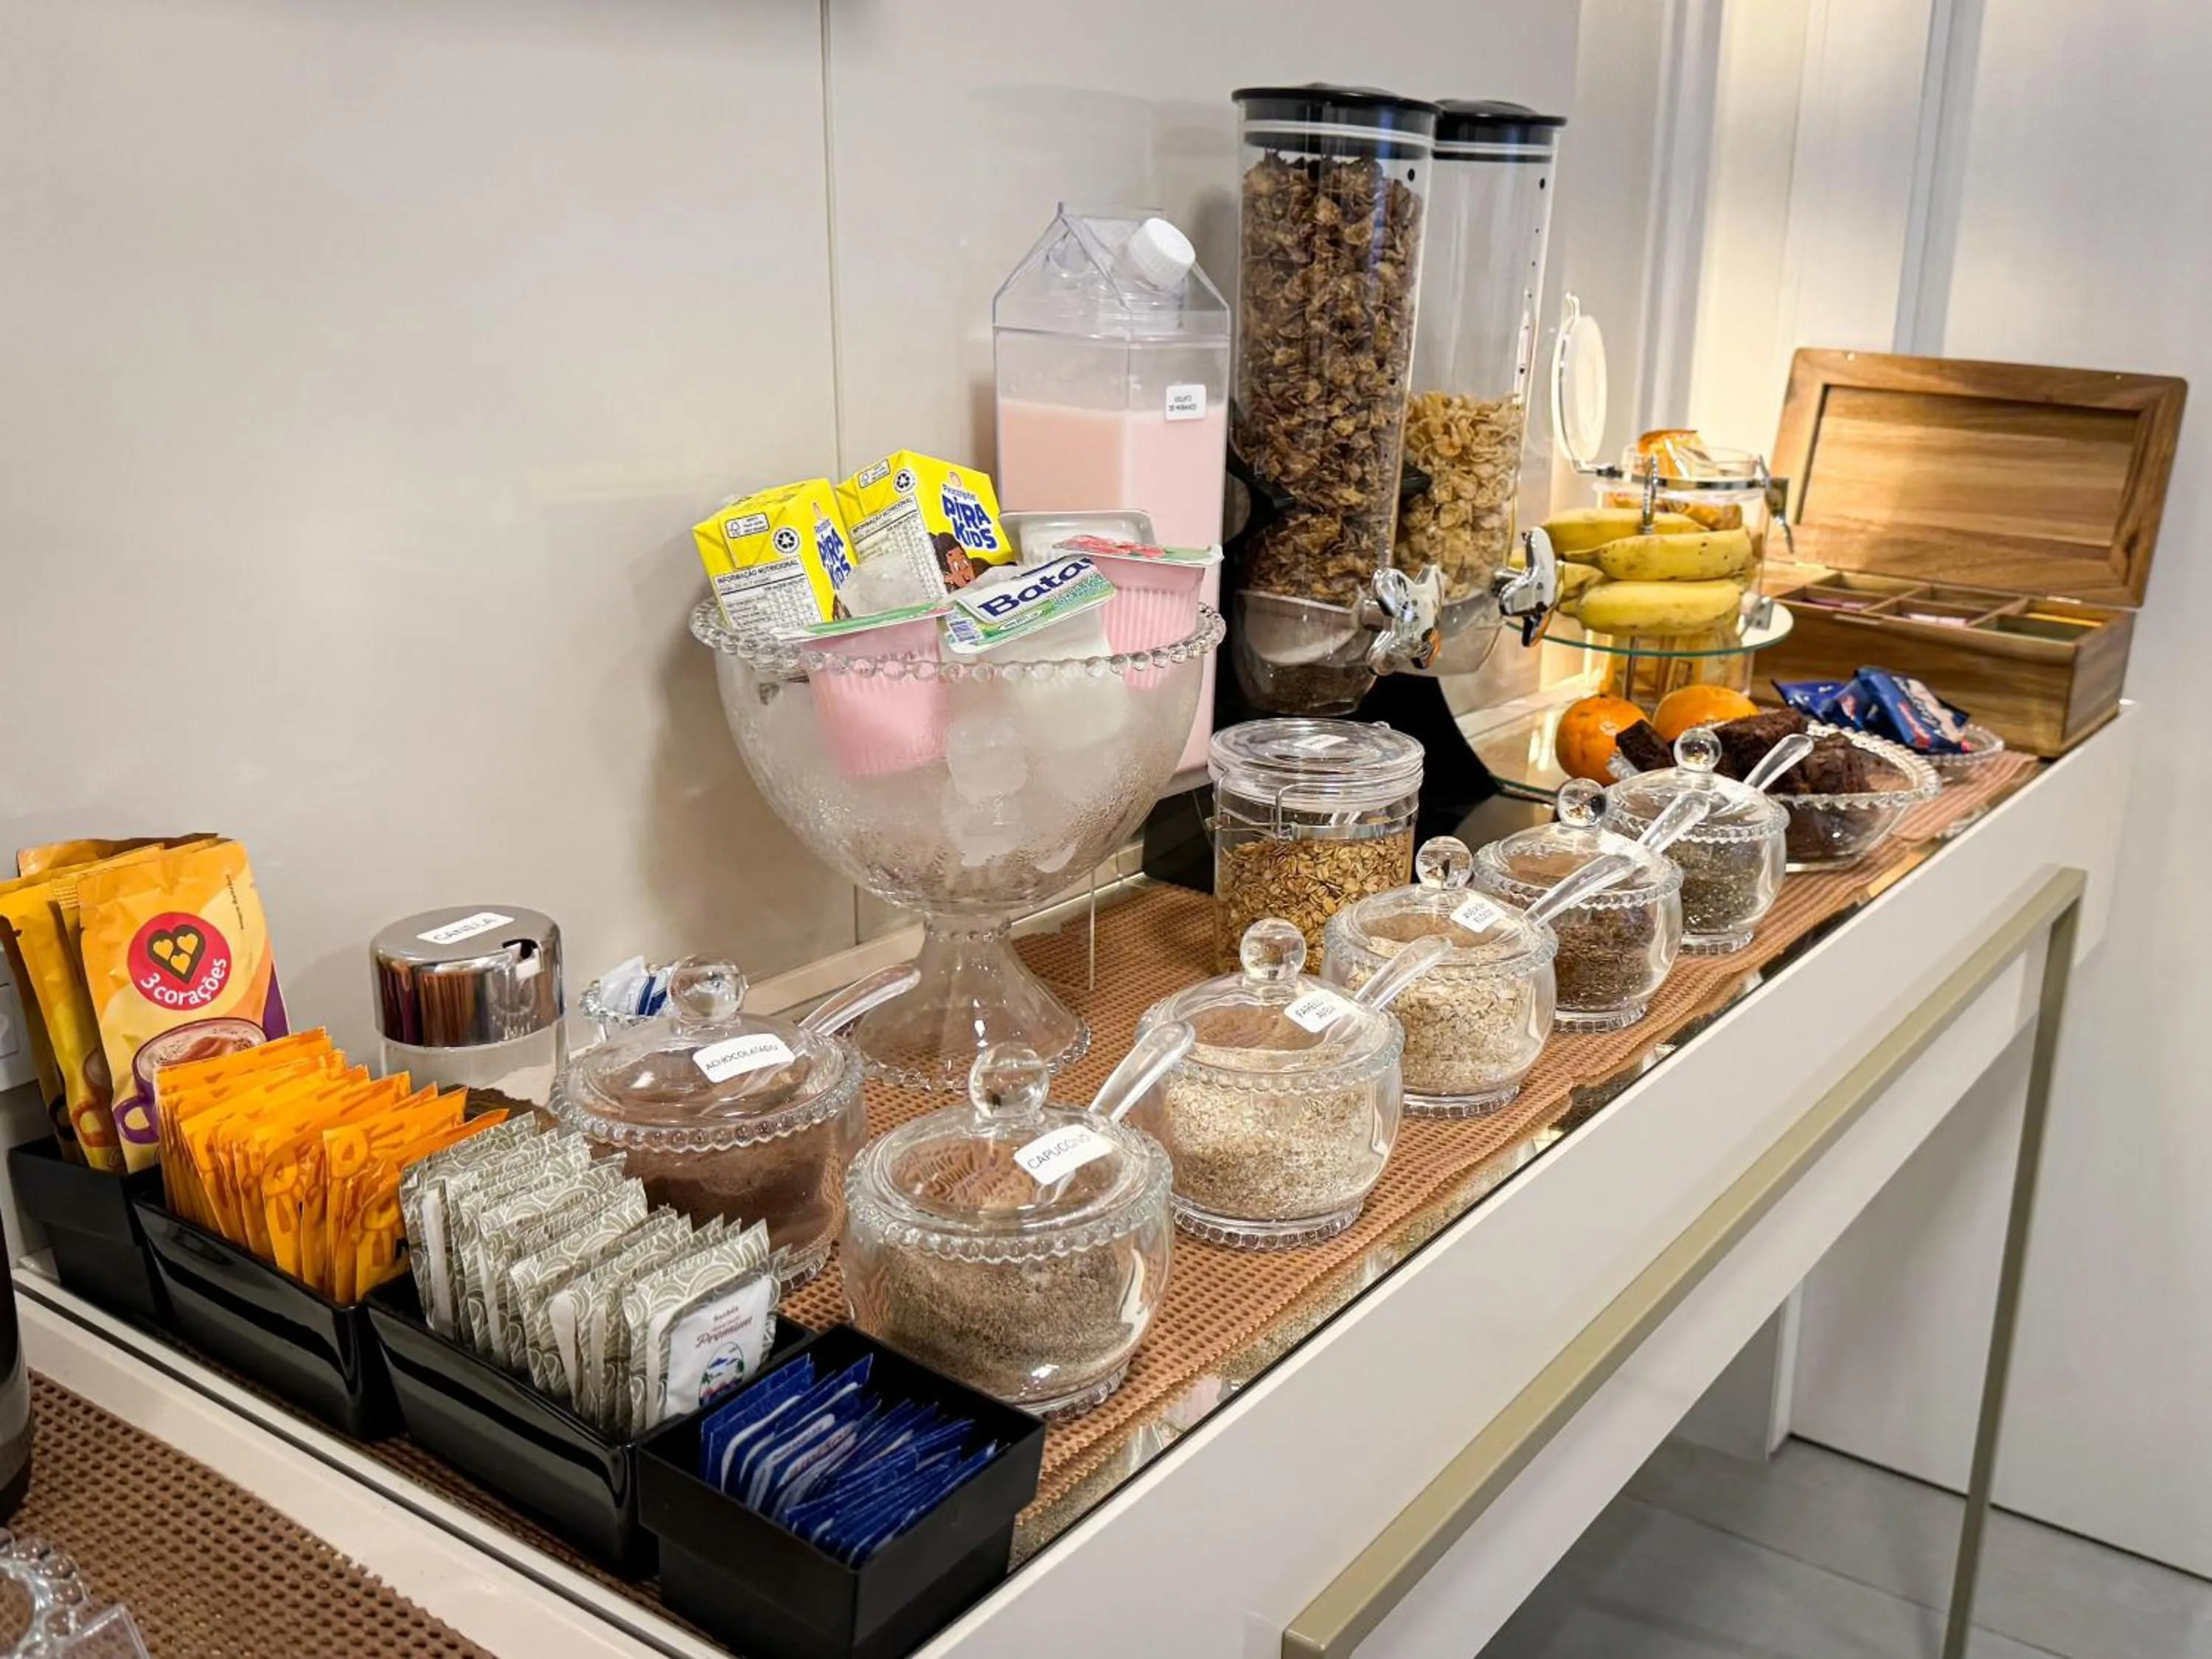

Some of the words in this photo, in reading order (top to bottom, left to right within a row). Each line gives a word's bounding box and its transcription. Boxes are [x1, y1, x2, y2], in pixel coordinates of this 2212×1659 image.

[977, 557, 1095, 616] Bata
[140, 973, 161, 989] 3
[153, 959, 226, 1005] corações
